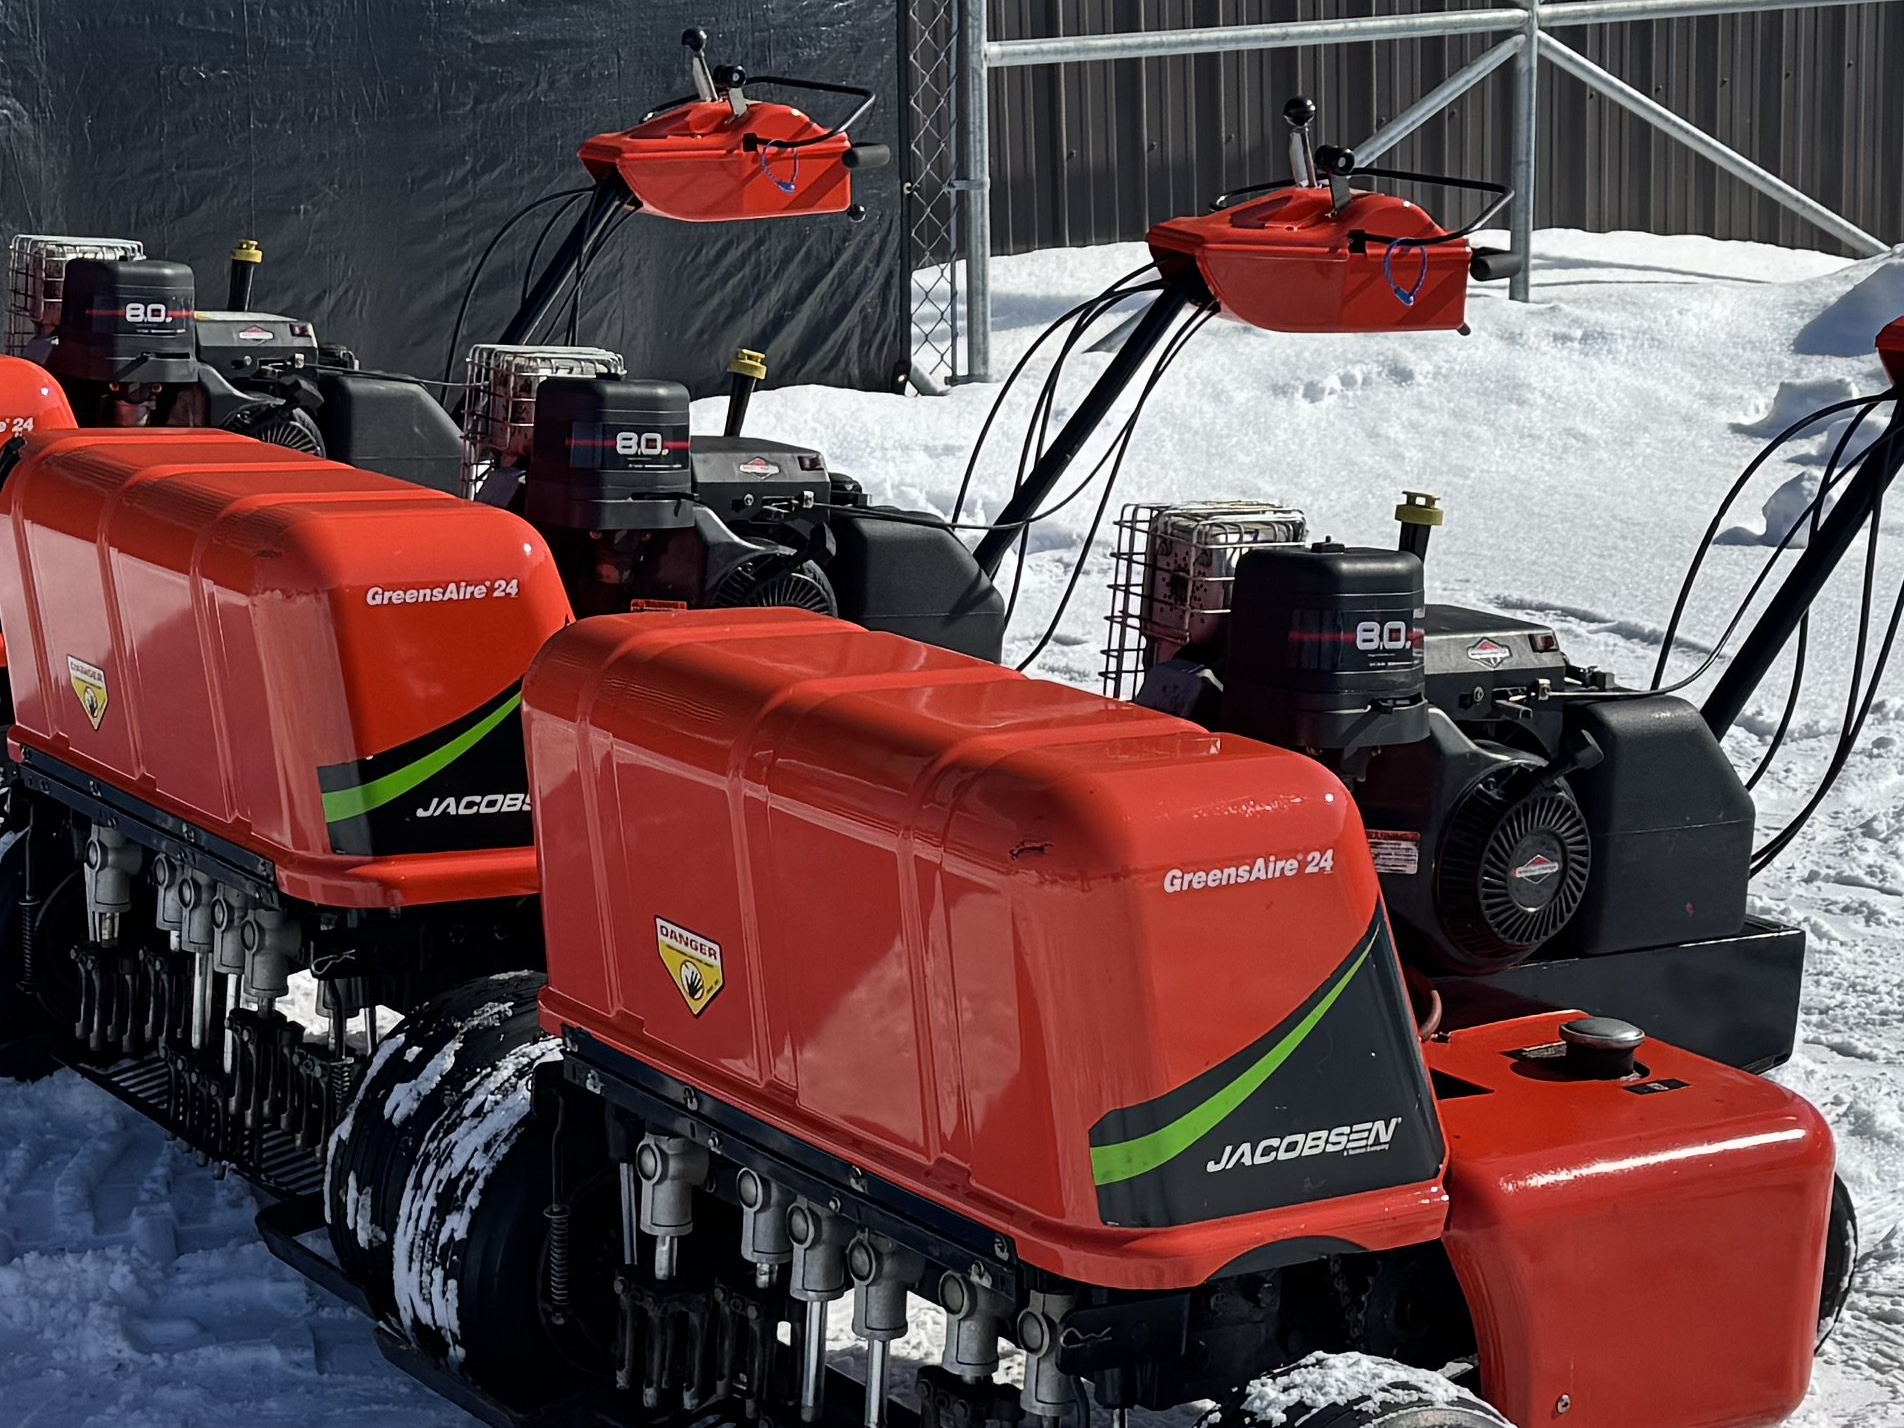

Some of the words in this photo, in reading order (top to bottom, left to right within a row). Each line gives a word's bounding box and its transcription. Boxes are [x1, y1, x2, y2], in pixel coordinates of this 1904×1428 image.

[11, 417, 34, 433] 24
[493, 578, 519, 598] 24
[1304, 848, 1334, 874] 24
[659, 924, 717, 960] DANGER
[1206, 1117, 1398, 1173] JACOBSEN
